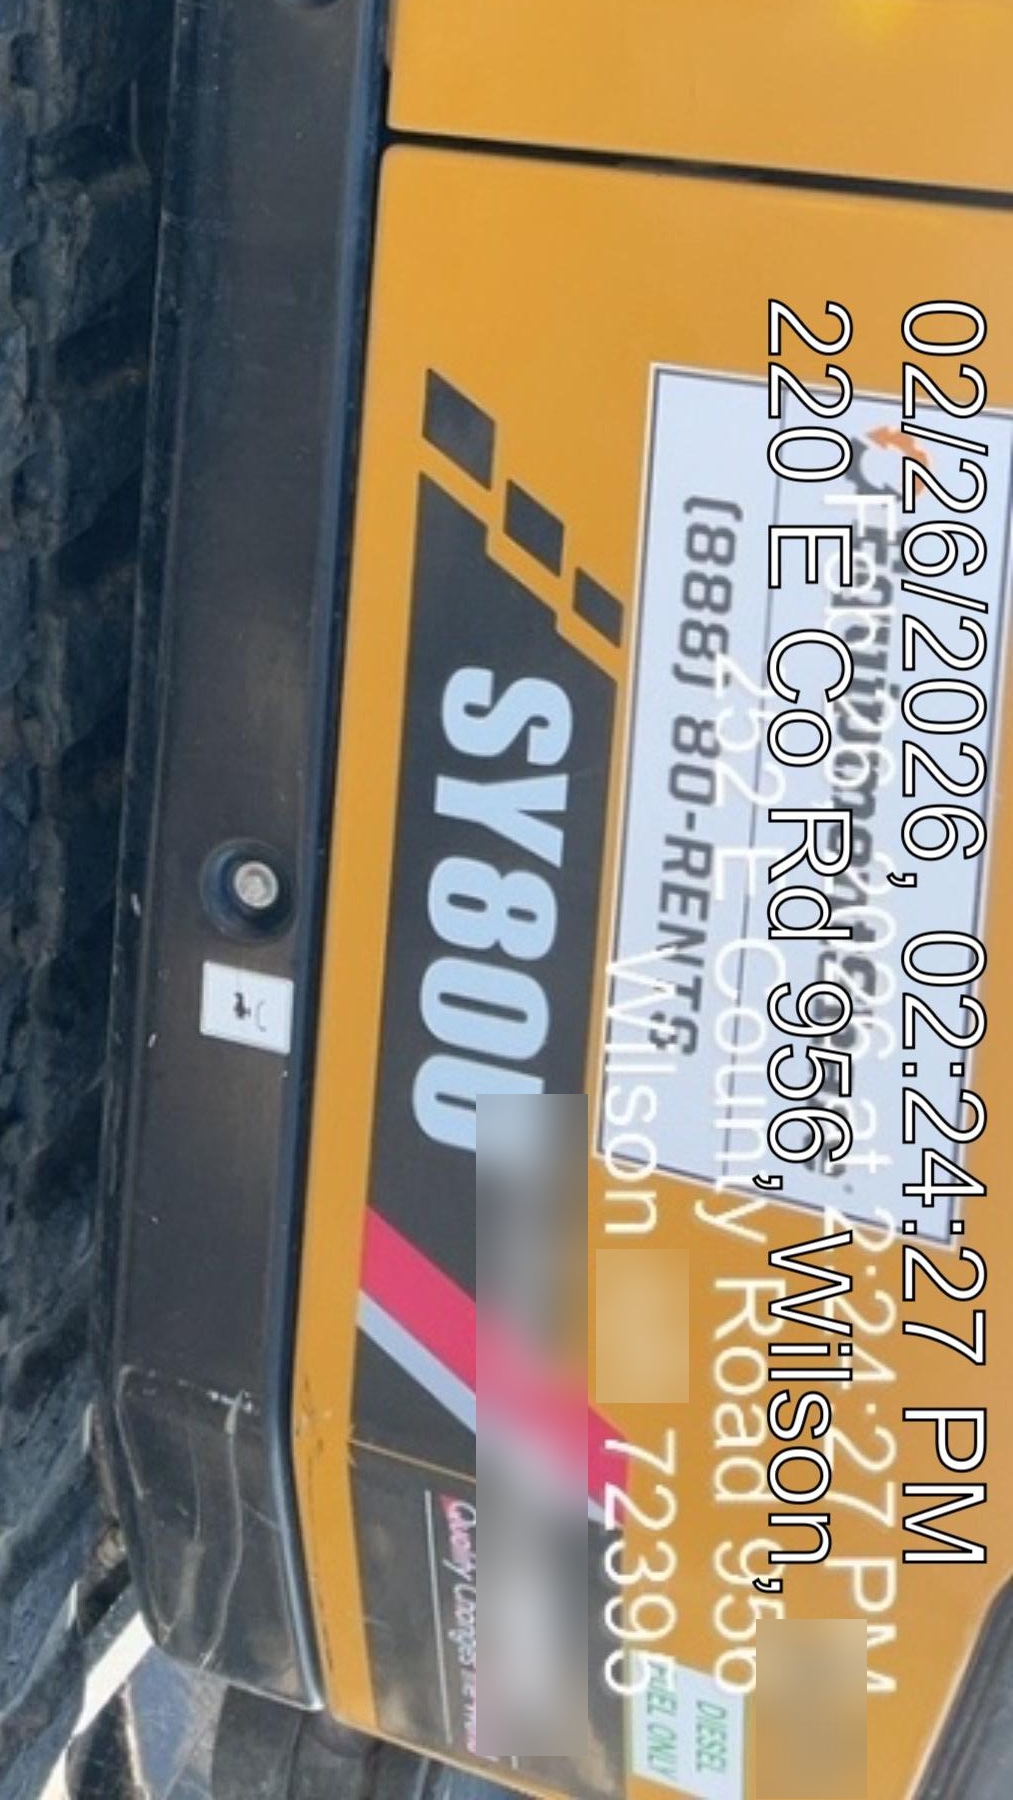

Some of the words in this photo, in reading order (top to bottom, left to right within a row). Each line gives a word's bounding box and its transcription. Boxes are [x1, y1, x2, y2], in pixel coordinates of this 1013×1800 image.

[673, 495, 744, 688] (888)
[649, 715, 723, 1055] 80-RENTS
[647, 1722, 679, 1782] ONLY
[696, 1700, 728, 1775] DIESEL
